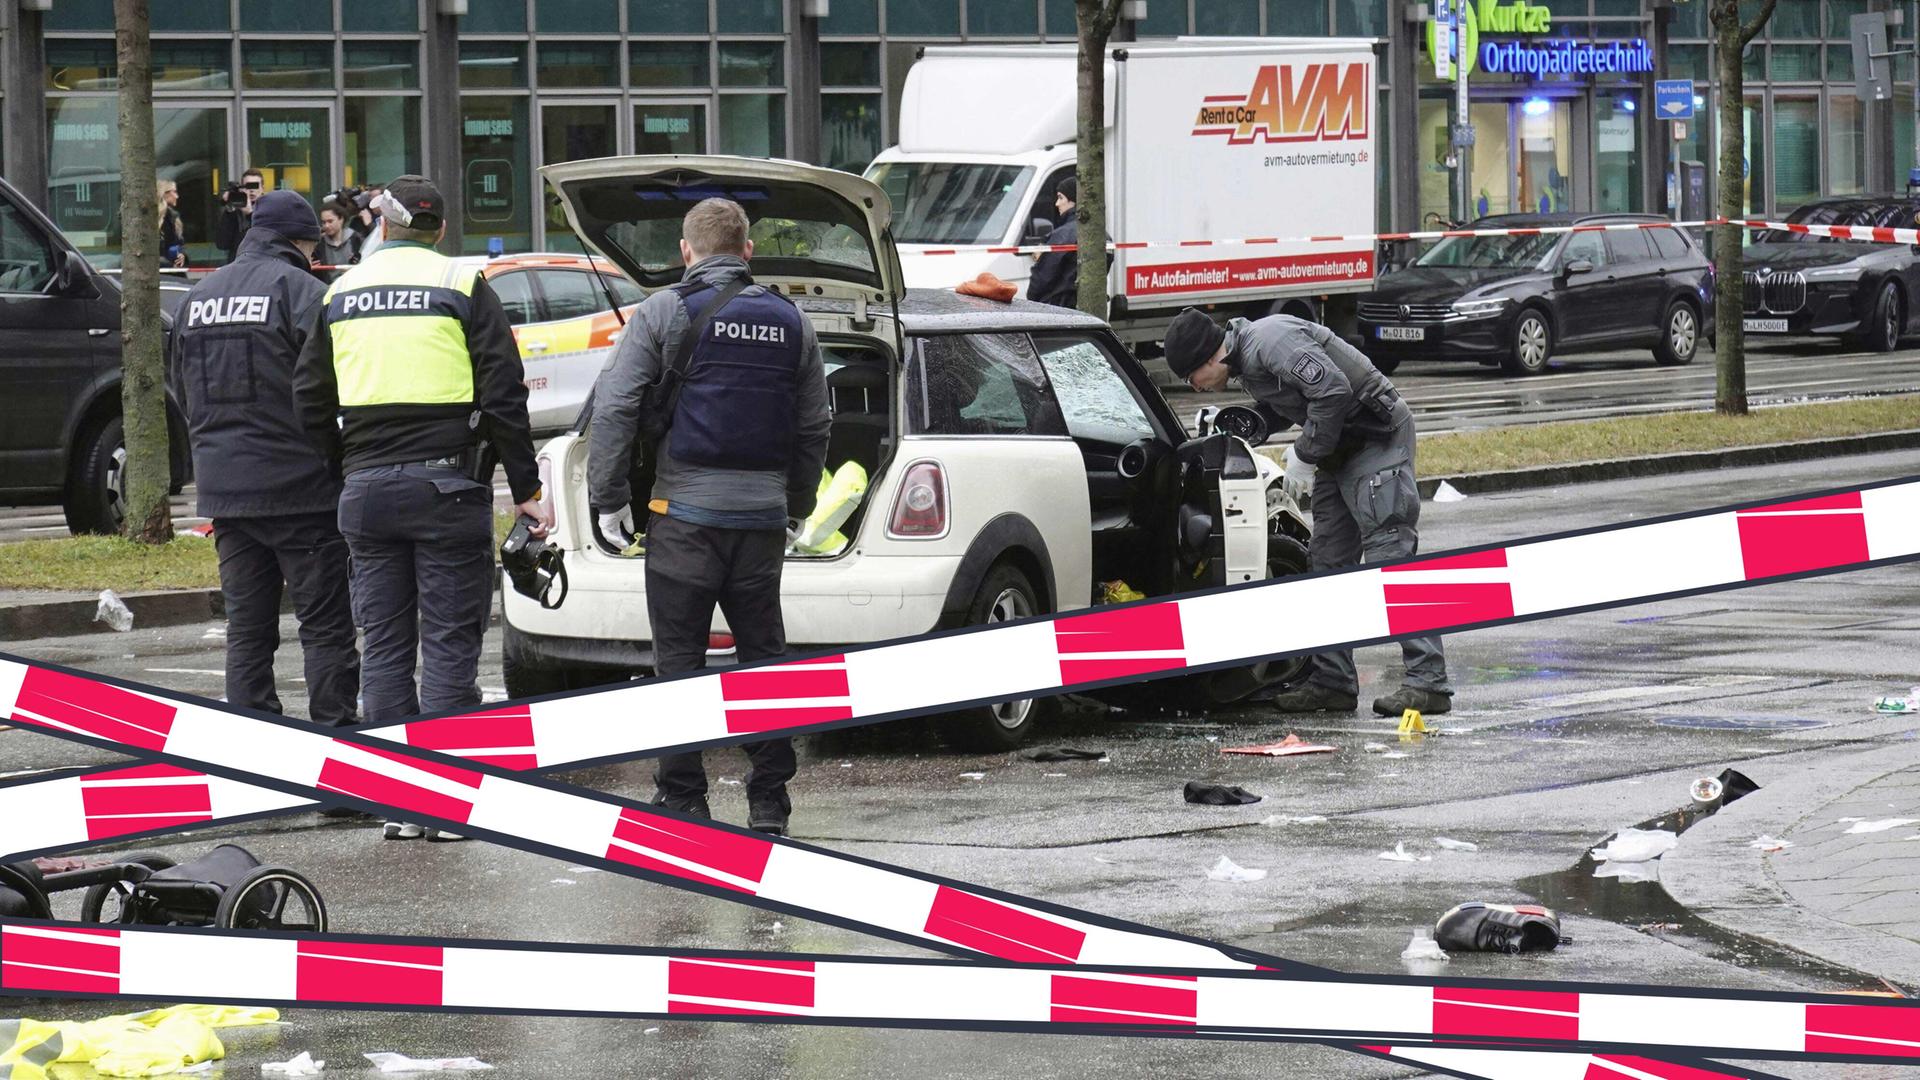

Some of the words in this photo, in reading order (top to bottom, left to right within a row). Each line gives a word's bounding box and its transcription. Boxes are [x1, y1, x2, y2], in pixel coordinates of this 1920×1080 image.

[1480, 0, 1551, 33] Kurtze
[1482, 38, 1653, 81] Orthopädietechnik
[1236, 62, 1367, 140] AVM
[1201, 107, 1225, 124] Rent
[1235, 106, 1256, 123] Car
[1264, 149, 1368, 167] avm-autovermietung.de
[1134, 273, 1149, 289] Ihr
[1151, 267, 1230, 288] Autofairmieter!
[187, 295, 270, 327] POLIZEI
[343, 290, 431, 314] POLIZEI
[714, 321, 785, 343] POLIZEI
